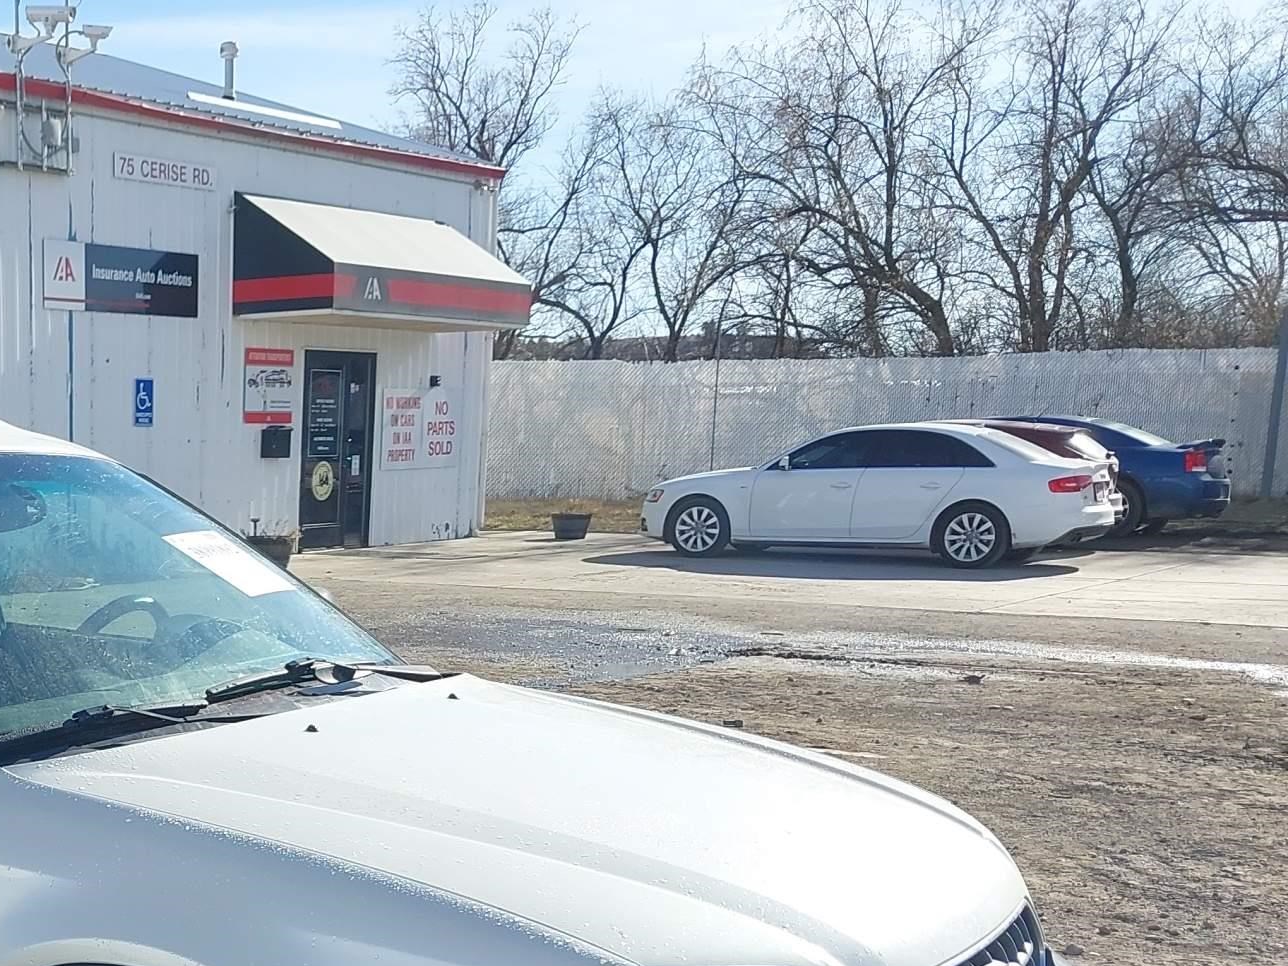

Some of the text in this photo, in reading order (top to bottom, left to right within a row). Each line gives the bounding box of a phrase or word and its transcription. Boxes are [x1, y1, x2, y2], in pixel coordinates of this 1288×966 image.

[119, 156, 214, 187] 75 CERISE RD.
[92, 263, 193, 288] Insurance Auto Auctions
[435, 401, 448, 415] NO
[391, 414, 415, 427] ON CARS
[427, 421, 455, 436] PARTS
[393, 432, 400, 444] ON
[387, 448, 416, 462] PROPERTY
[428, 441, 452, 456] SOLD
